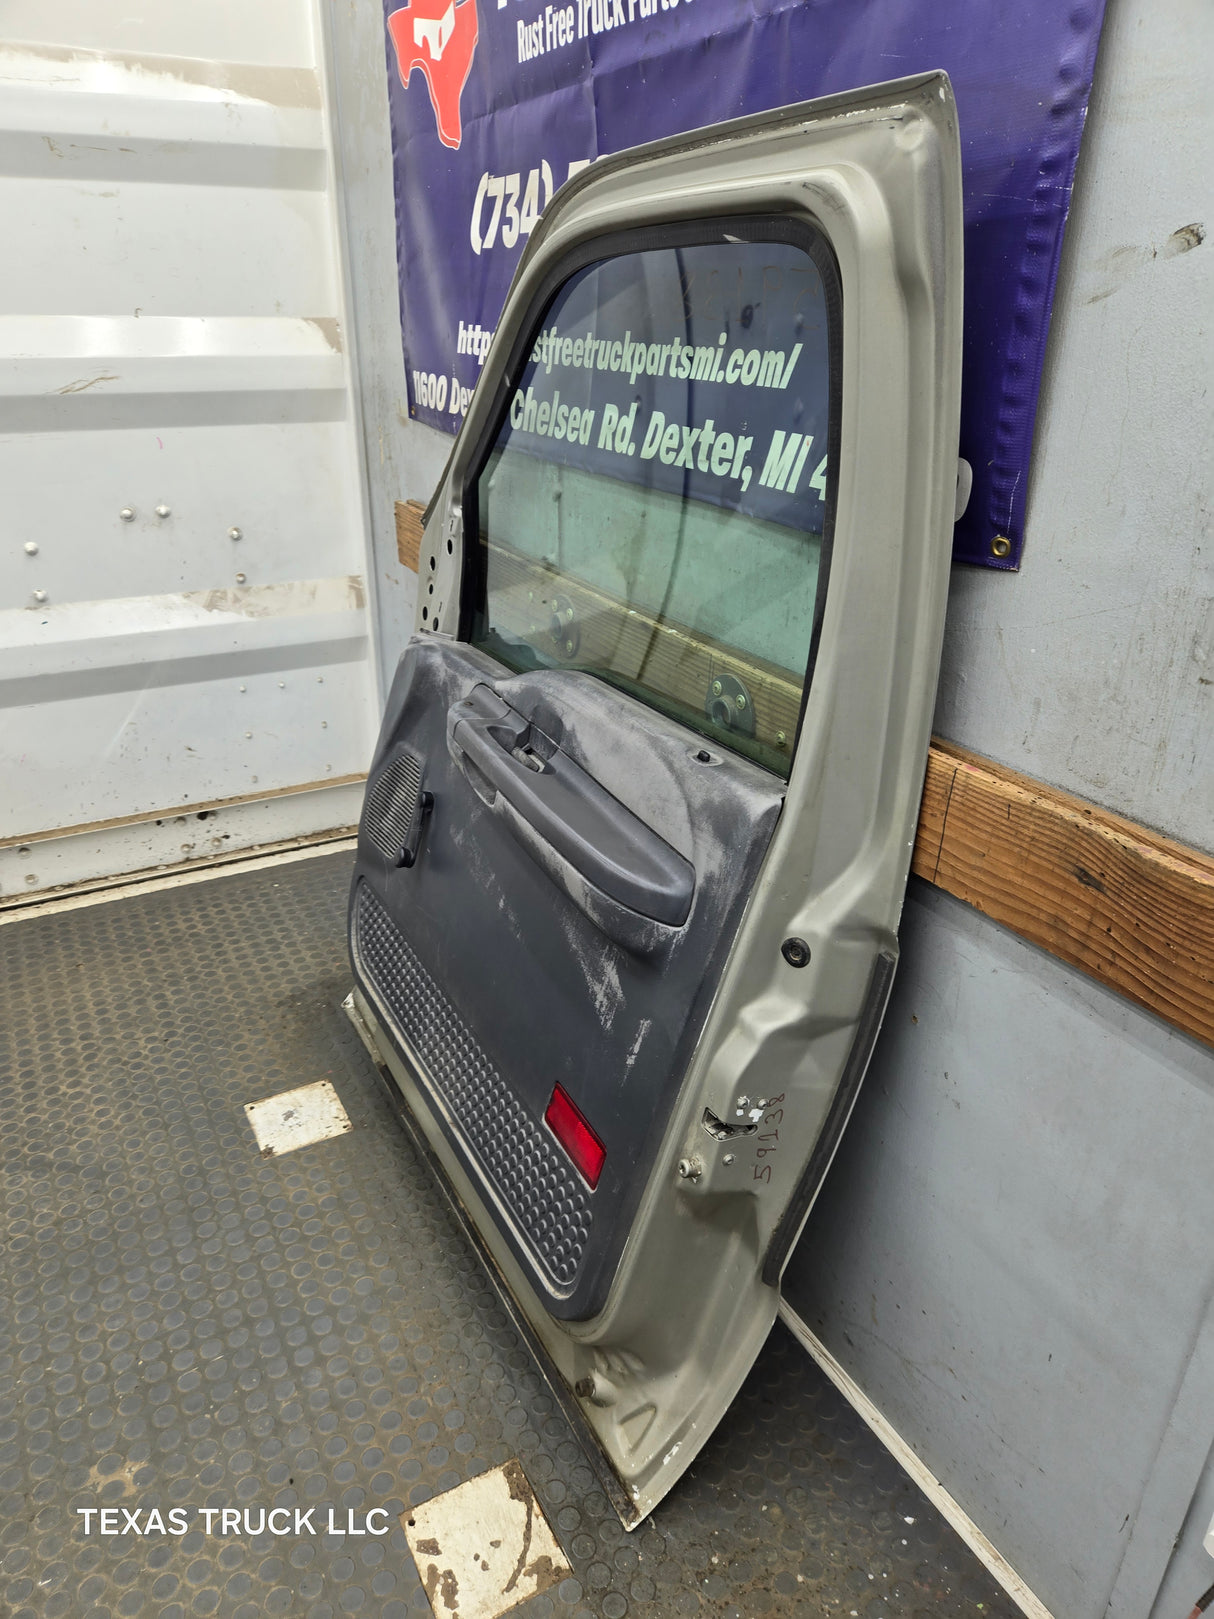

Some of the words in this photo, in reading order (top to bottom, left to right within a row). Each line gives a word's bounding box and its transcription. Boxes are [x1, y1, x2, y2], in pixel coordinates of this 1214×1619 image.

[516, 14, 545, 64] Rust
[545, 5, 574, 52] Free
[457, 320, 495, 365] http
[413, 370, 448, 412] 11600
[510, 386, 595, 446] Chelsea
[597, 402, 638, 456] Rd.
[640, 410, 754, 492] Dexter,
[758, 429, 814, 494] MI
[753, 1092, 785, 1184] 59138
